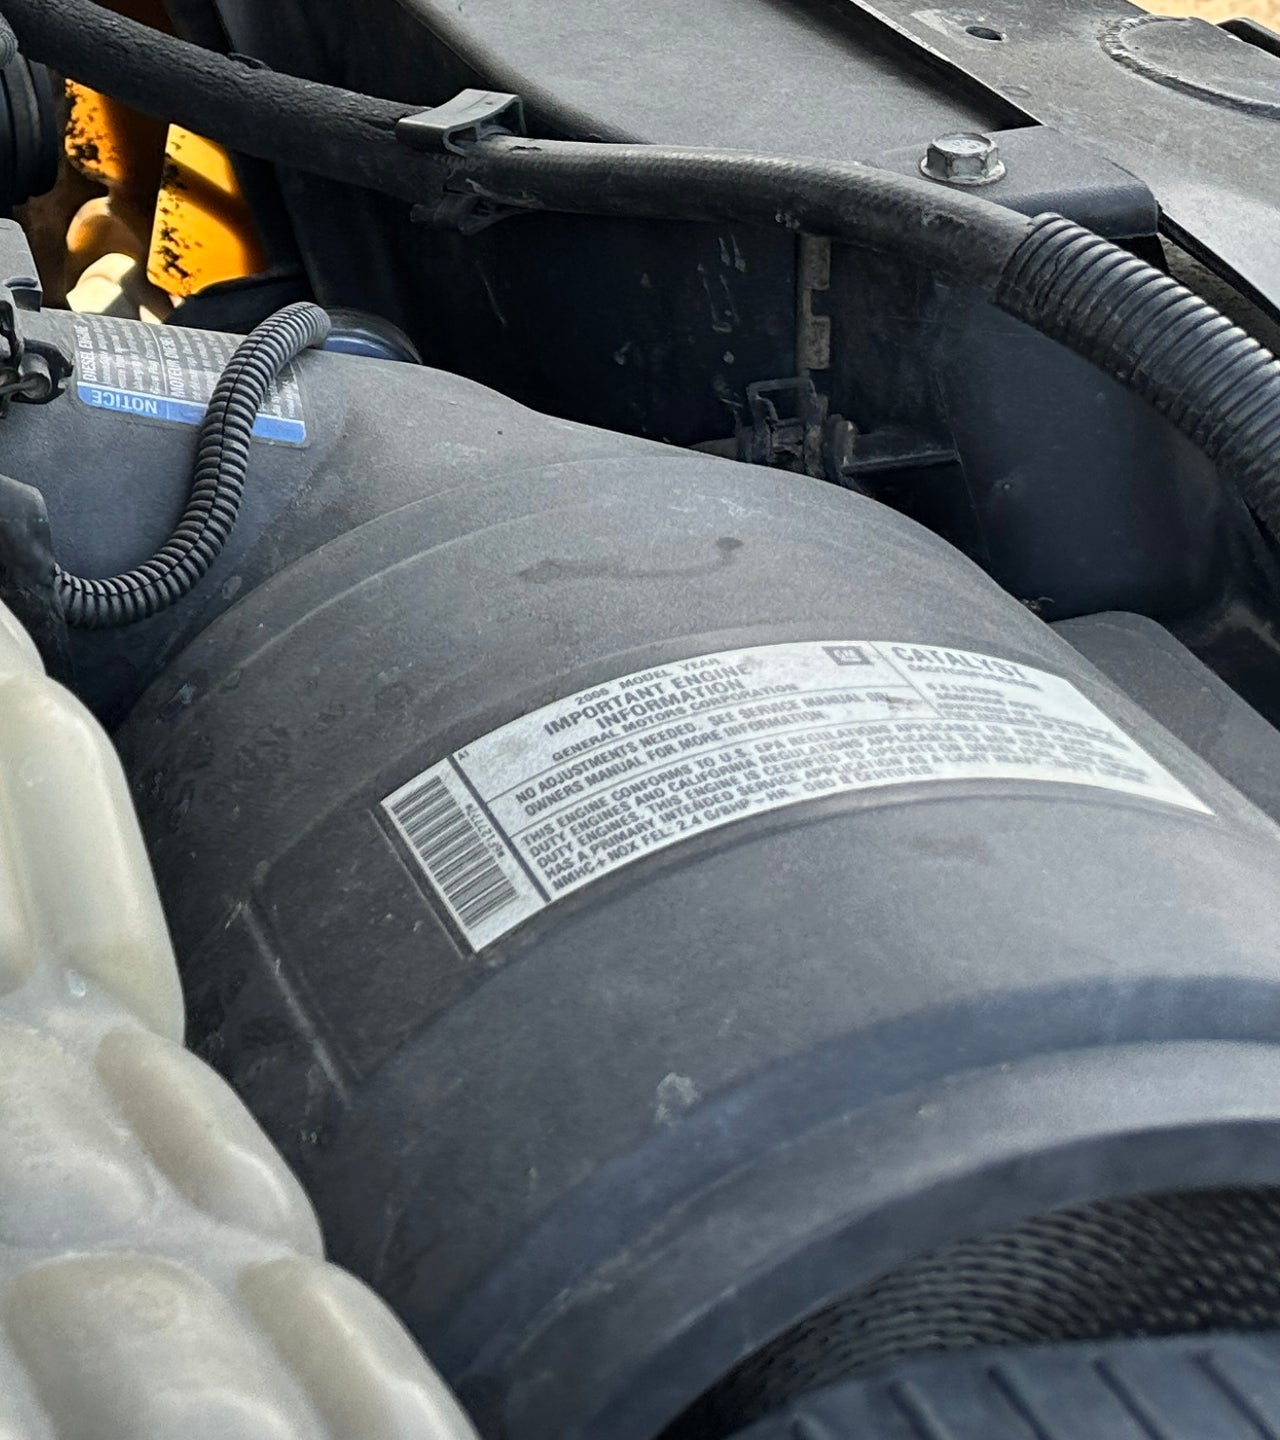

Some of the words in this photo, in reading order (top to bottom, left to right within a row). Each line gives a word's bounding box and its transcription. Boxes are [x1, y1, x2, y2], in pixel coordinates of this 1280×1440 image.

[79, 348, 97, 382] DIESEL
[91, 389, 158, 415] NOTICE
[544, 683, 664, 736] IMPORTANT
[673, 663, 752, 689] ENGINE
[619, 669, 673, 690] MODEL
[680, 657, 721, 672] YEAR
[891, 646, 1027, 680] CATALYST
[552, 730, 620, 761] GENERAL
[623, 707, 685, 733] MOTORS
[690, 683, 799, 712] CORPORATION
[595, 678, 745, 729] INFORMATION
[515, 786, 536, 805] NO
[539, 741, 638, 795] ADJUSTMENTS
[710, 710, 736, 727] SEE
[742, 698, 800, 720] SERVICE
[525, 781, 584, 817] OWNERS
[585, 758, 646, 790] MANUAL
[647, 743, 676, 763] FOR
[679, 729, 722, 751] MORE
[521, 826, 555, 847] THIS
[557, 797, 608, 827] ENGINE
[611, 765, 693, 802] CONFORMS
[697, 755, 715, 769] TO
[529, 832, 566, 857] DUTY
[569, 803, 632, 835] ENGINES
[635, 786, 666, 806] AND
[669, 758, 756, 792] CALIFORNIA
[538, 844, 575, 869] DUTY
[647, 795, 682, 814] THIS
[684, 776, 739, 801] ENGINE
[743, 768, 761, 782] IS
[544, 859, 576, 880] HAS
[590, 817, 656, 856] PRIMARY
[658, 791, 733, 824] INTENDED
[736, 774, 801, 797] SERVICE
[607, 842, 639, 861] NOX
[676, 814, 703, 832] 2.4
